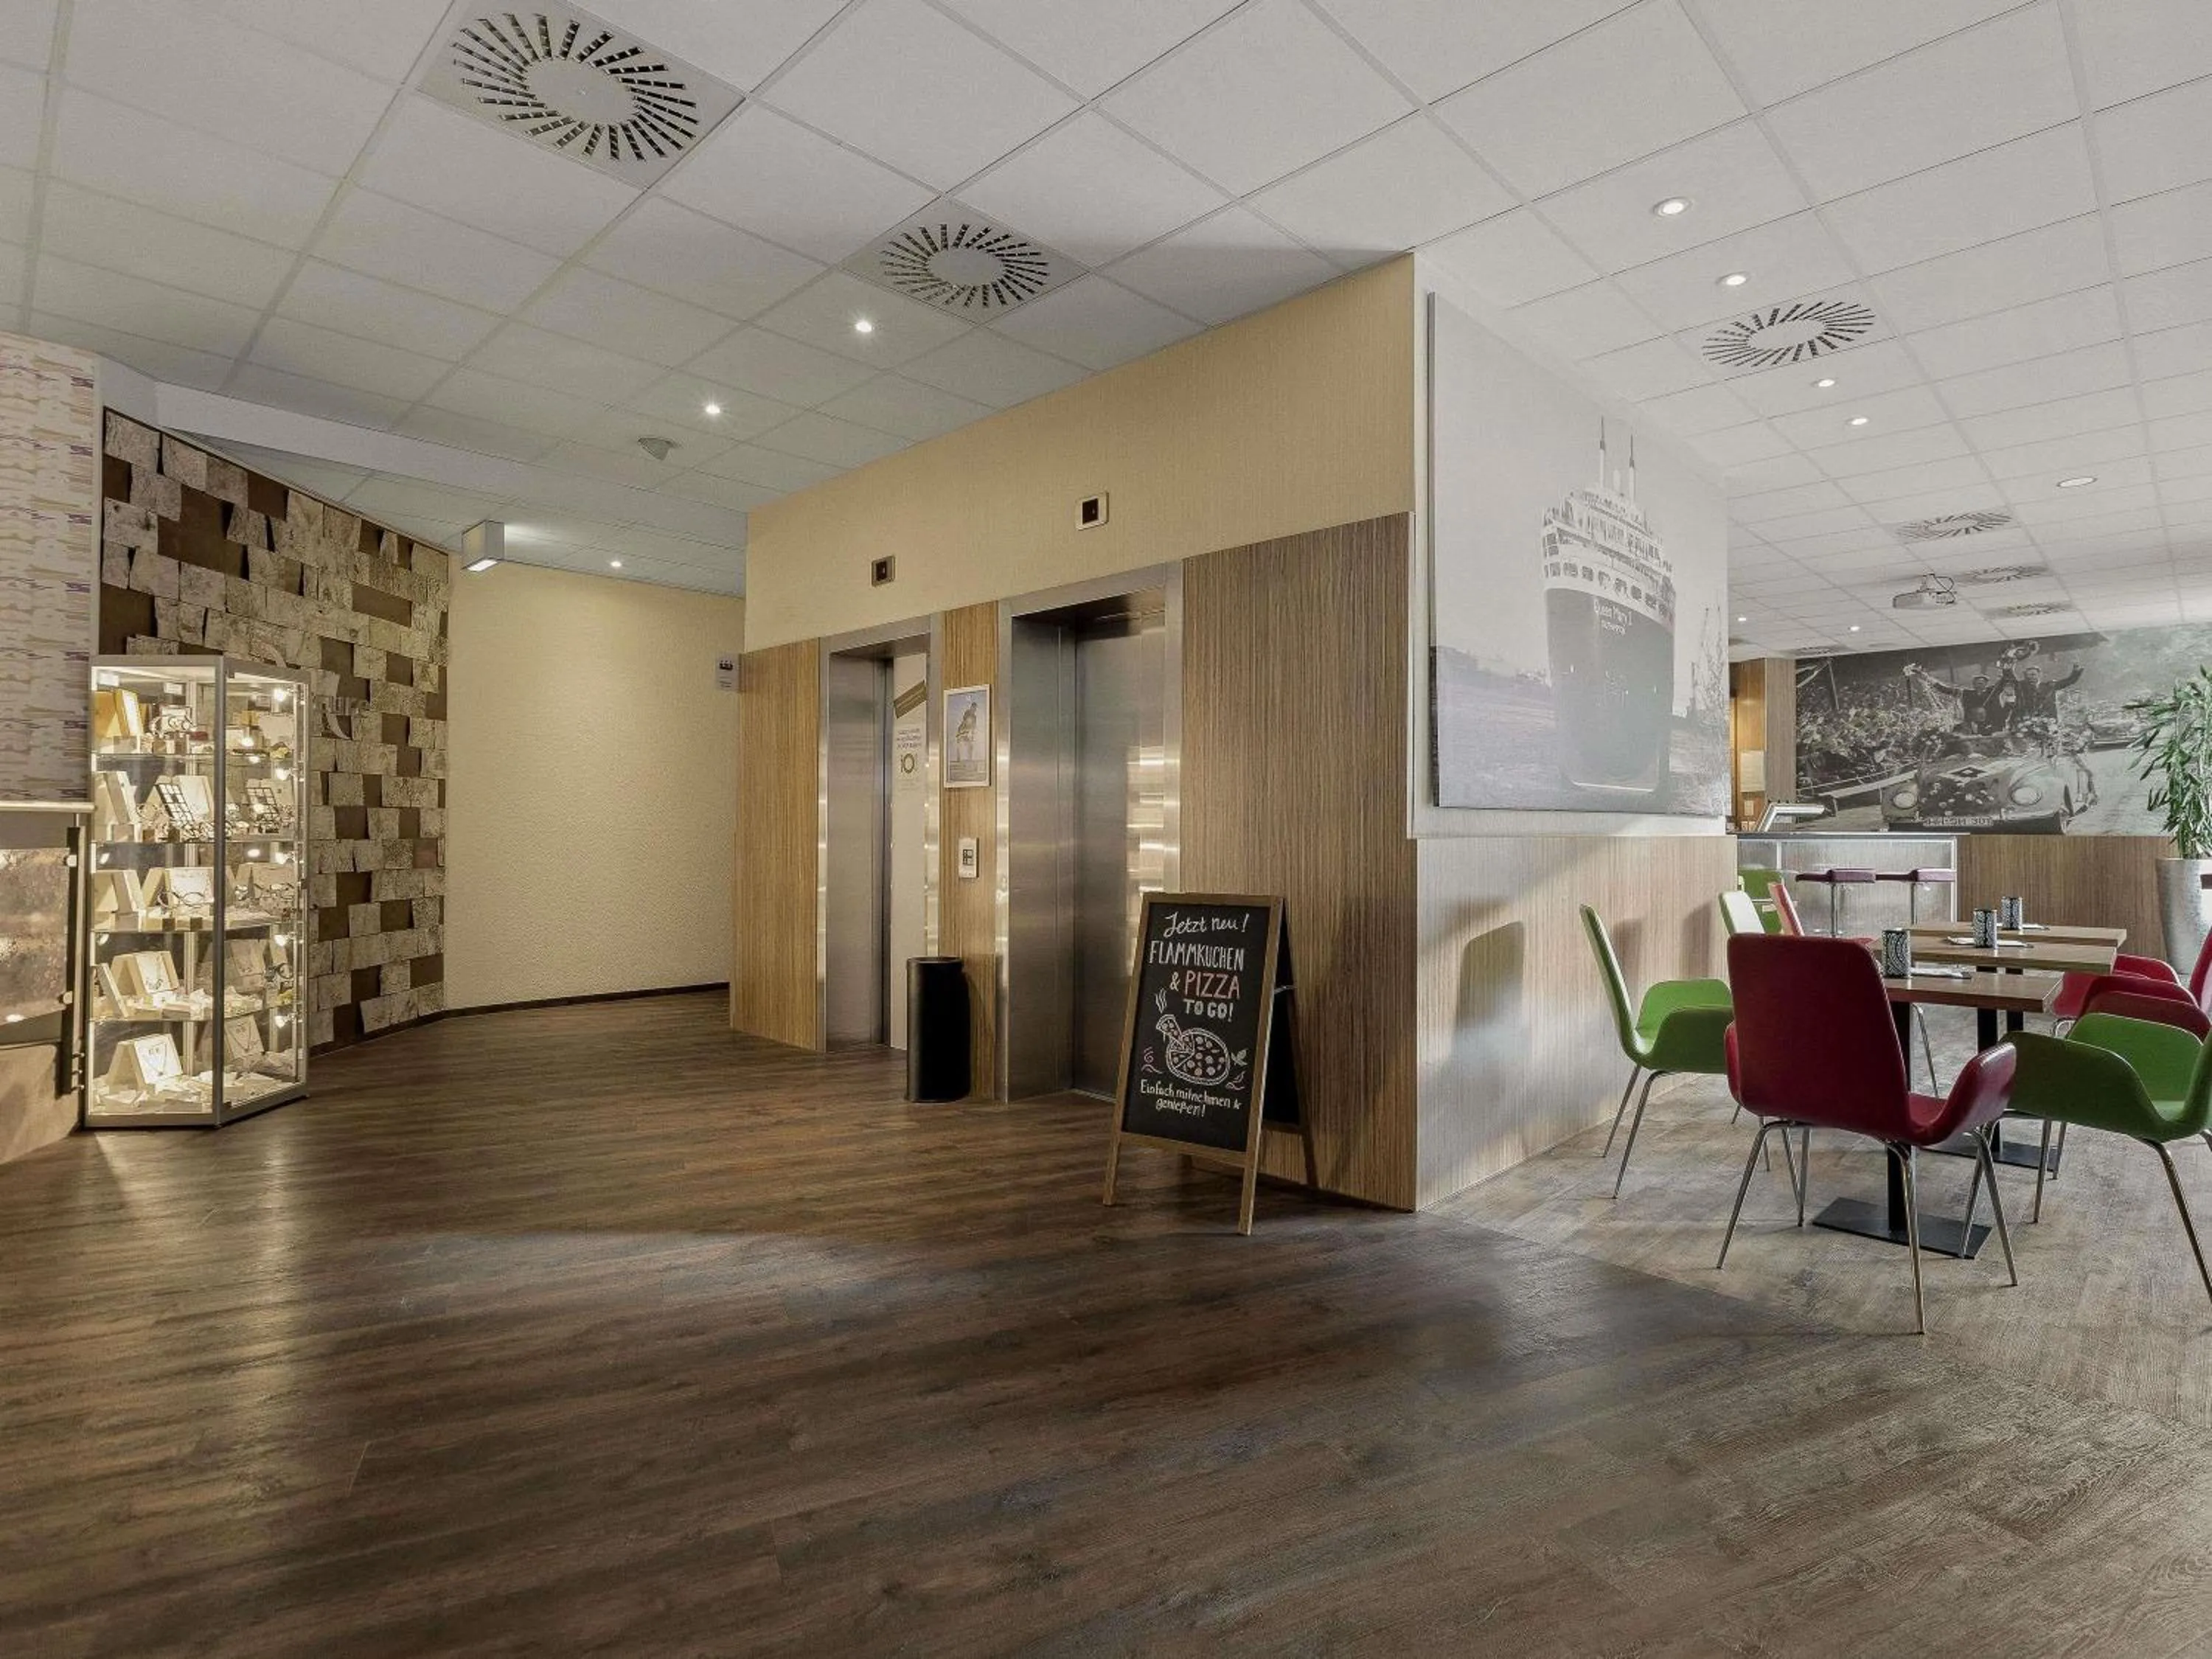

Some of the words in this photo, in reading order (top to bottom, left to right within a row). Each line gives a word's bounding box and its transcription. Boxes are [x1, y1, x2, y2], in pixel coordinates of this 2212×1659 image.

[1163, 911, 1208, 938] Jetzt
[1149, 940, 1245, 971] FLAMMKUCHEN
[1169, 971, 1180, 992] &
[1184, 970, 1240, 1000] PIZZA
[1183, 998, 1204, 1015] TO
[1206, 1001, 1234, 1023] GO!
[1140, 1079, 1175, 1097] Einfach
[1175, 1088, 1231, 1108] mitnehmen
